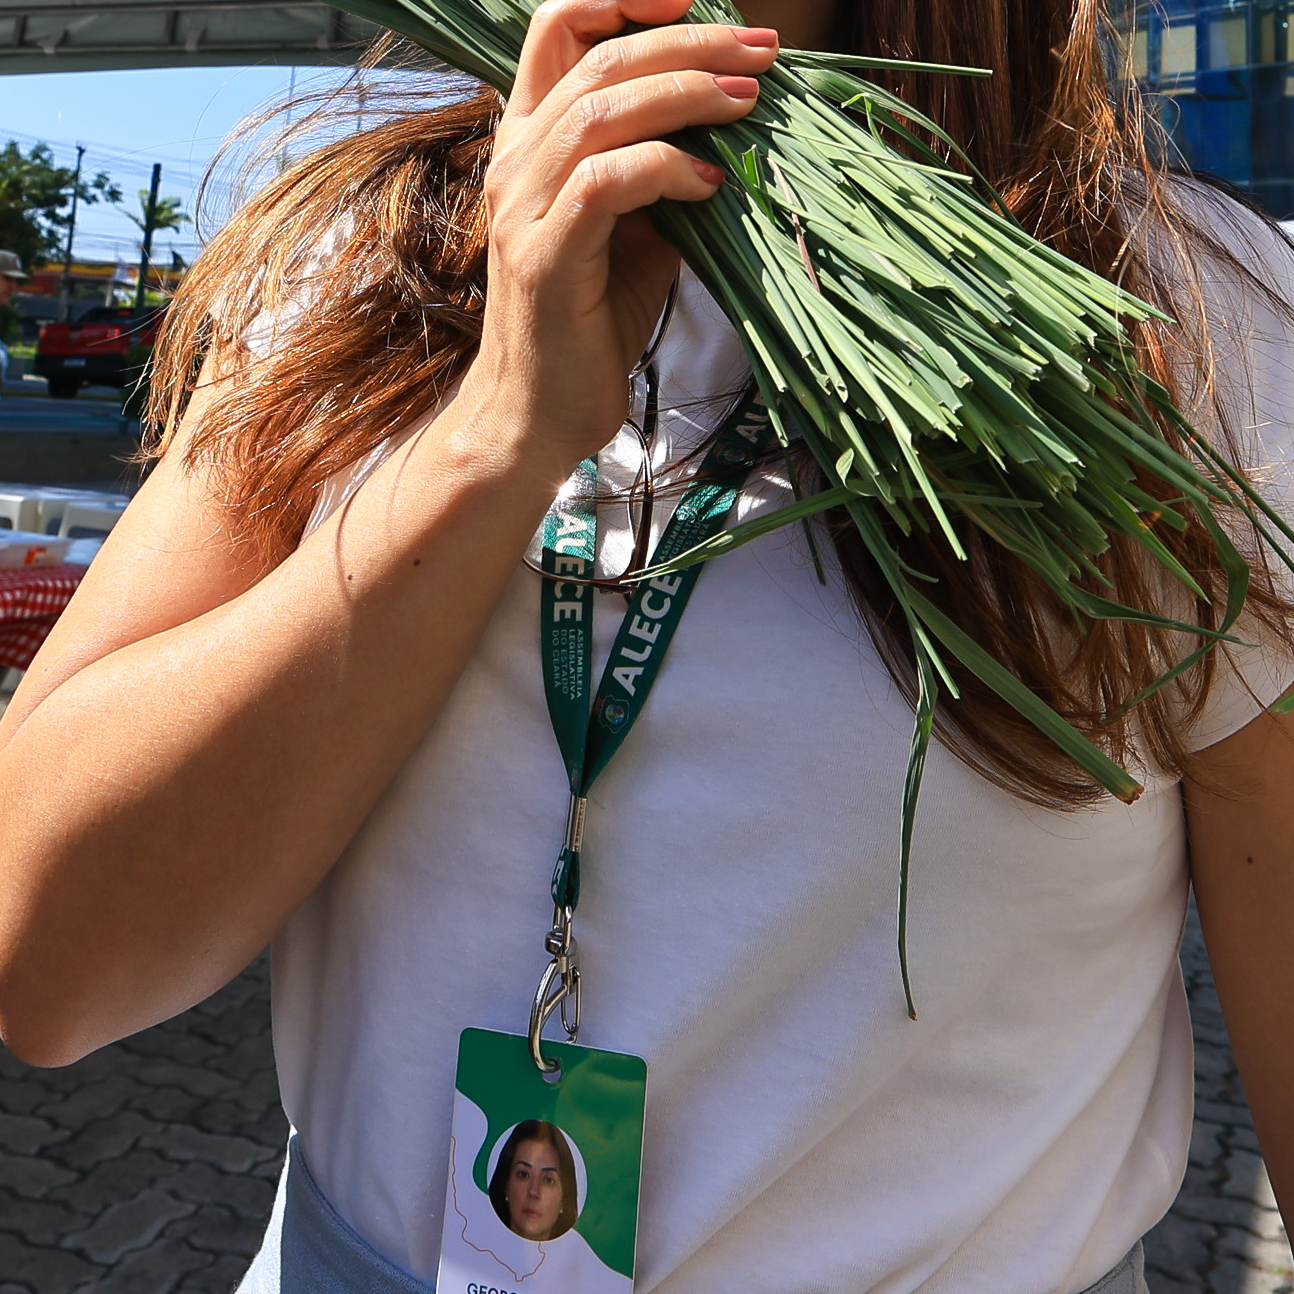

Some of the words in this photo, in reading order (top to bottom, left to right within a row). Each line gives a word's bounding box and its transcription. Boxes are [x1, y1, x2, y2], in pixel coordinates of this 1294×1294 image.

[553, 510, 588, 623] ALECE
[552, 629, 560, 646] DO
[560, 629, 568, 646] DO
[568, 628, 576, 701] LEGISLATIVA
[576, 628, 584, 699] ASSEMBLEIA
[611, 573, 683, 697] ALECE
[552, 649, 562, 688] CEARÁ
[560, 648, 569, 695] ESTADO
